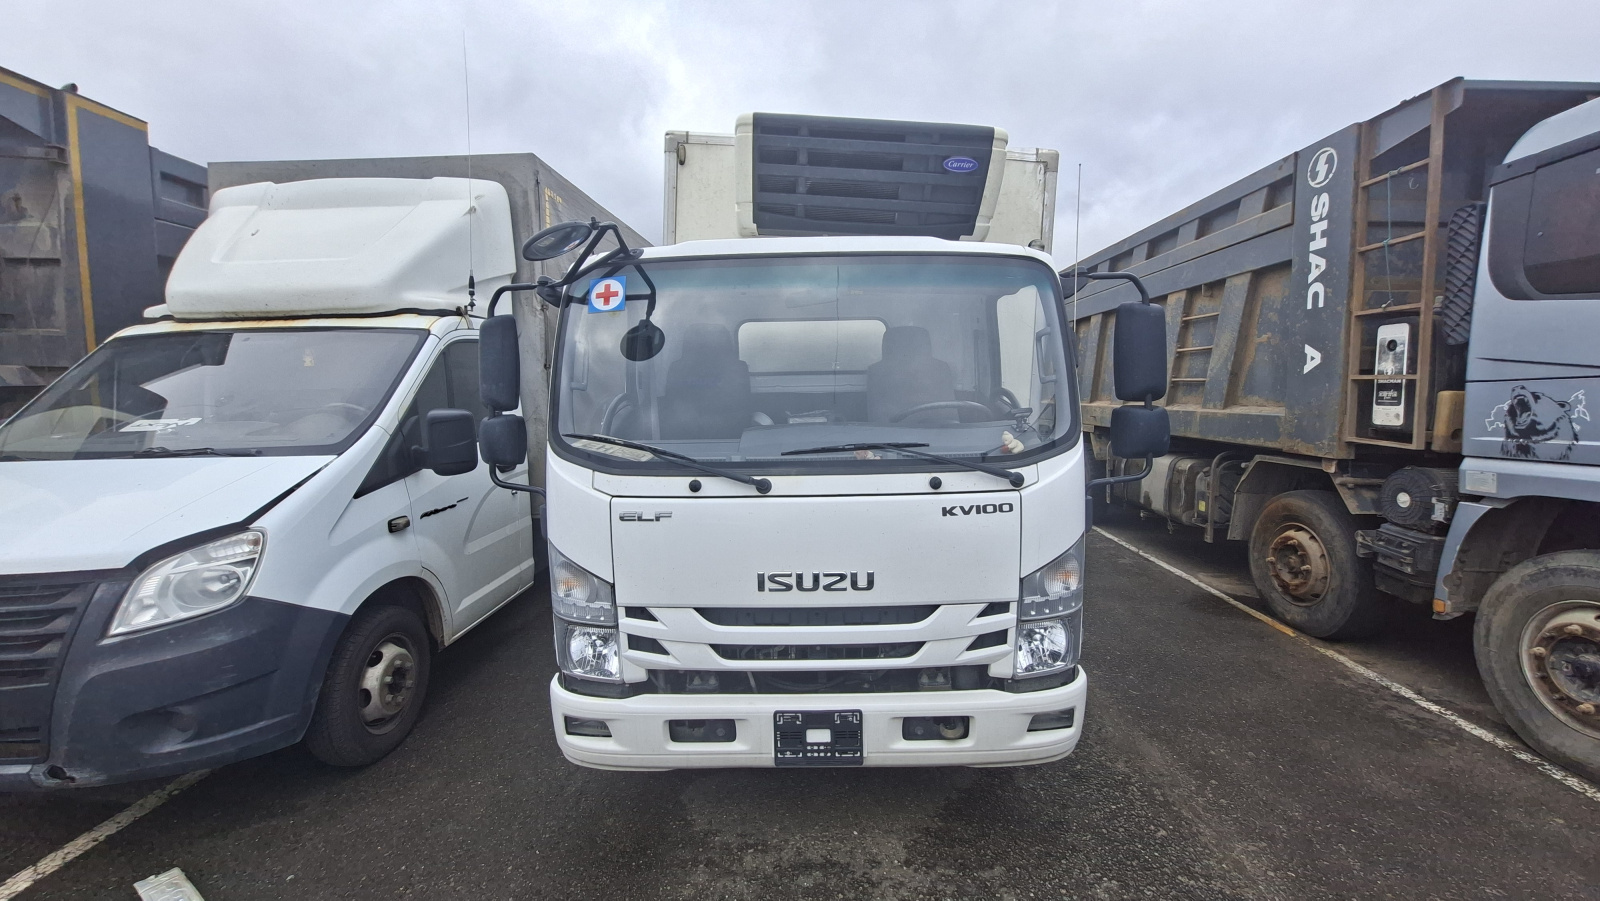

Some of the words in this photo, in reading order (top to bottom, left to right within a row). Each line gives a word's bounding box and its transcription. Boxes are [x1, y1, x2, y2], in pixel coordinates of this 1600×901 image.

[948, 160, 974, 168] Carrier
[1306, 192, 1330, 310] SHAC
[619, 510, 673, 522] ELF
[941, 502, 1014, 517] KV100
[757, 571, 875, 592] ISUZU
